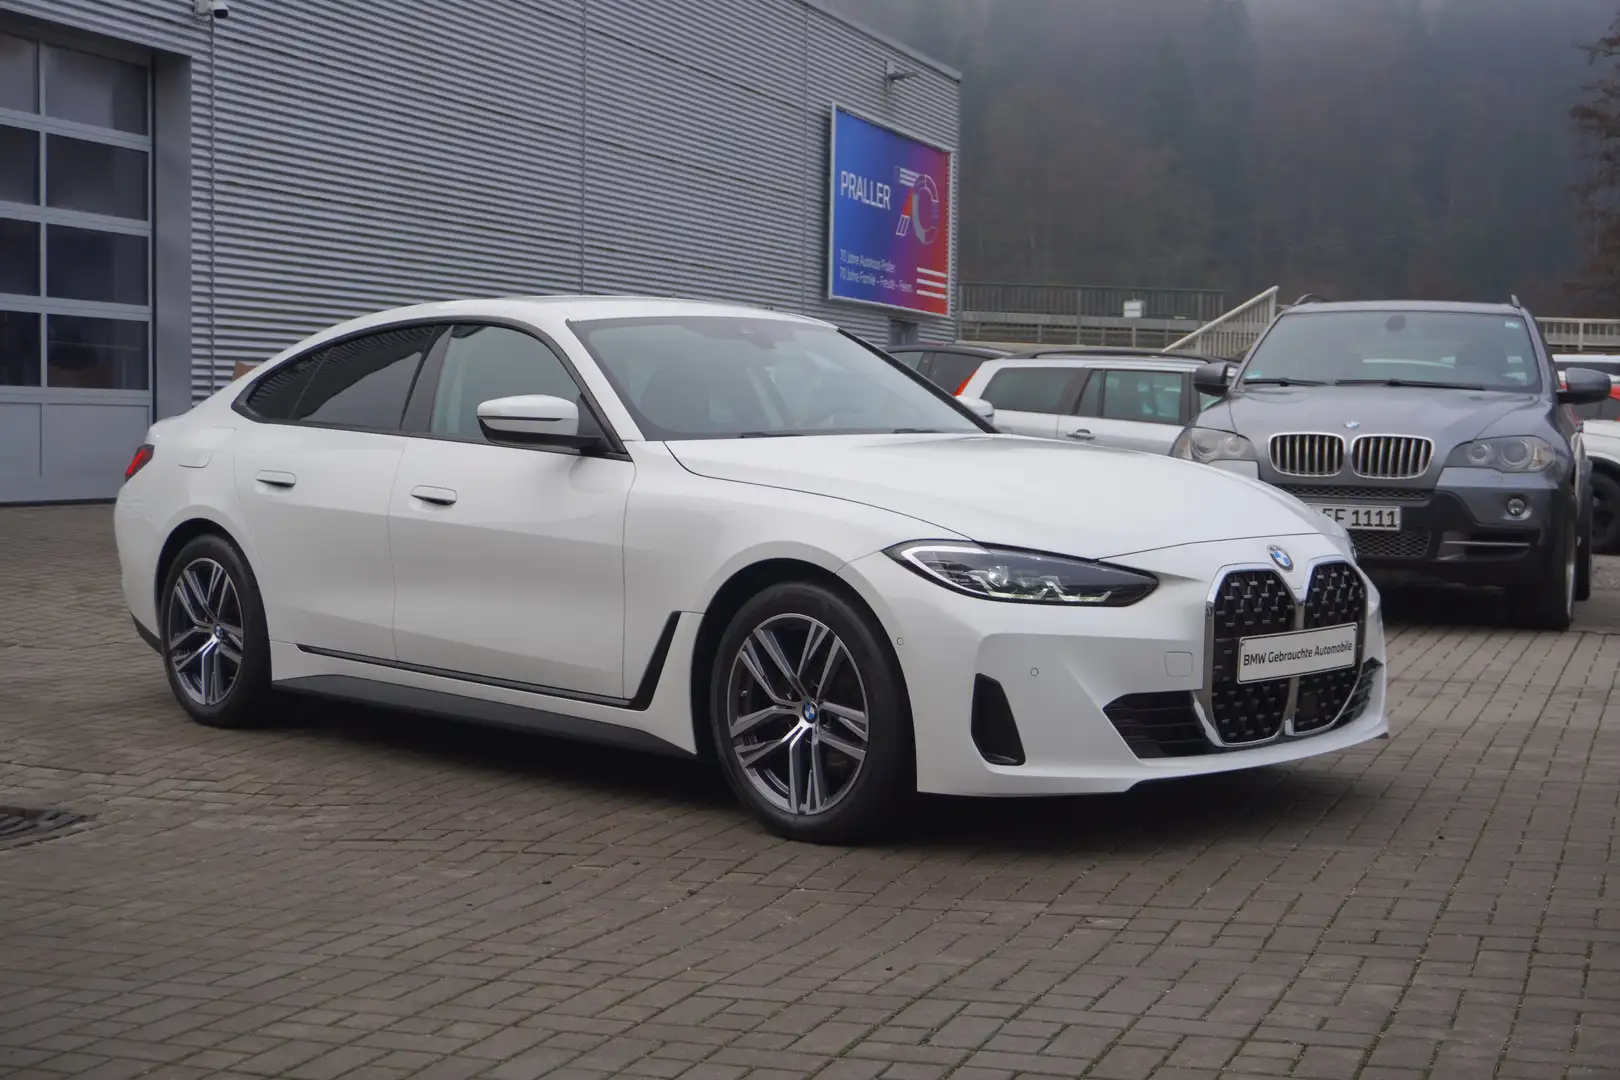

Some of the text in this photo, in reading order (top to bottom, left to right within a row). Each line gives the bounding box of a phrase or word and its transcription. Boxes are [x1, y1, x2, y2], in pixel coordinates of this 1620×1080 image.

[840, 170, 891, 211] PRALLER
[1351, 509, 1397, 528] 1111
[1243, 640, 1353, 666] BMW Gebrauchte Automobile
